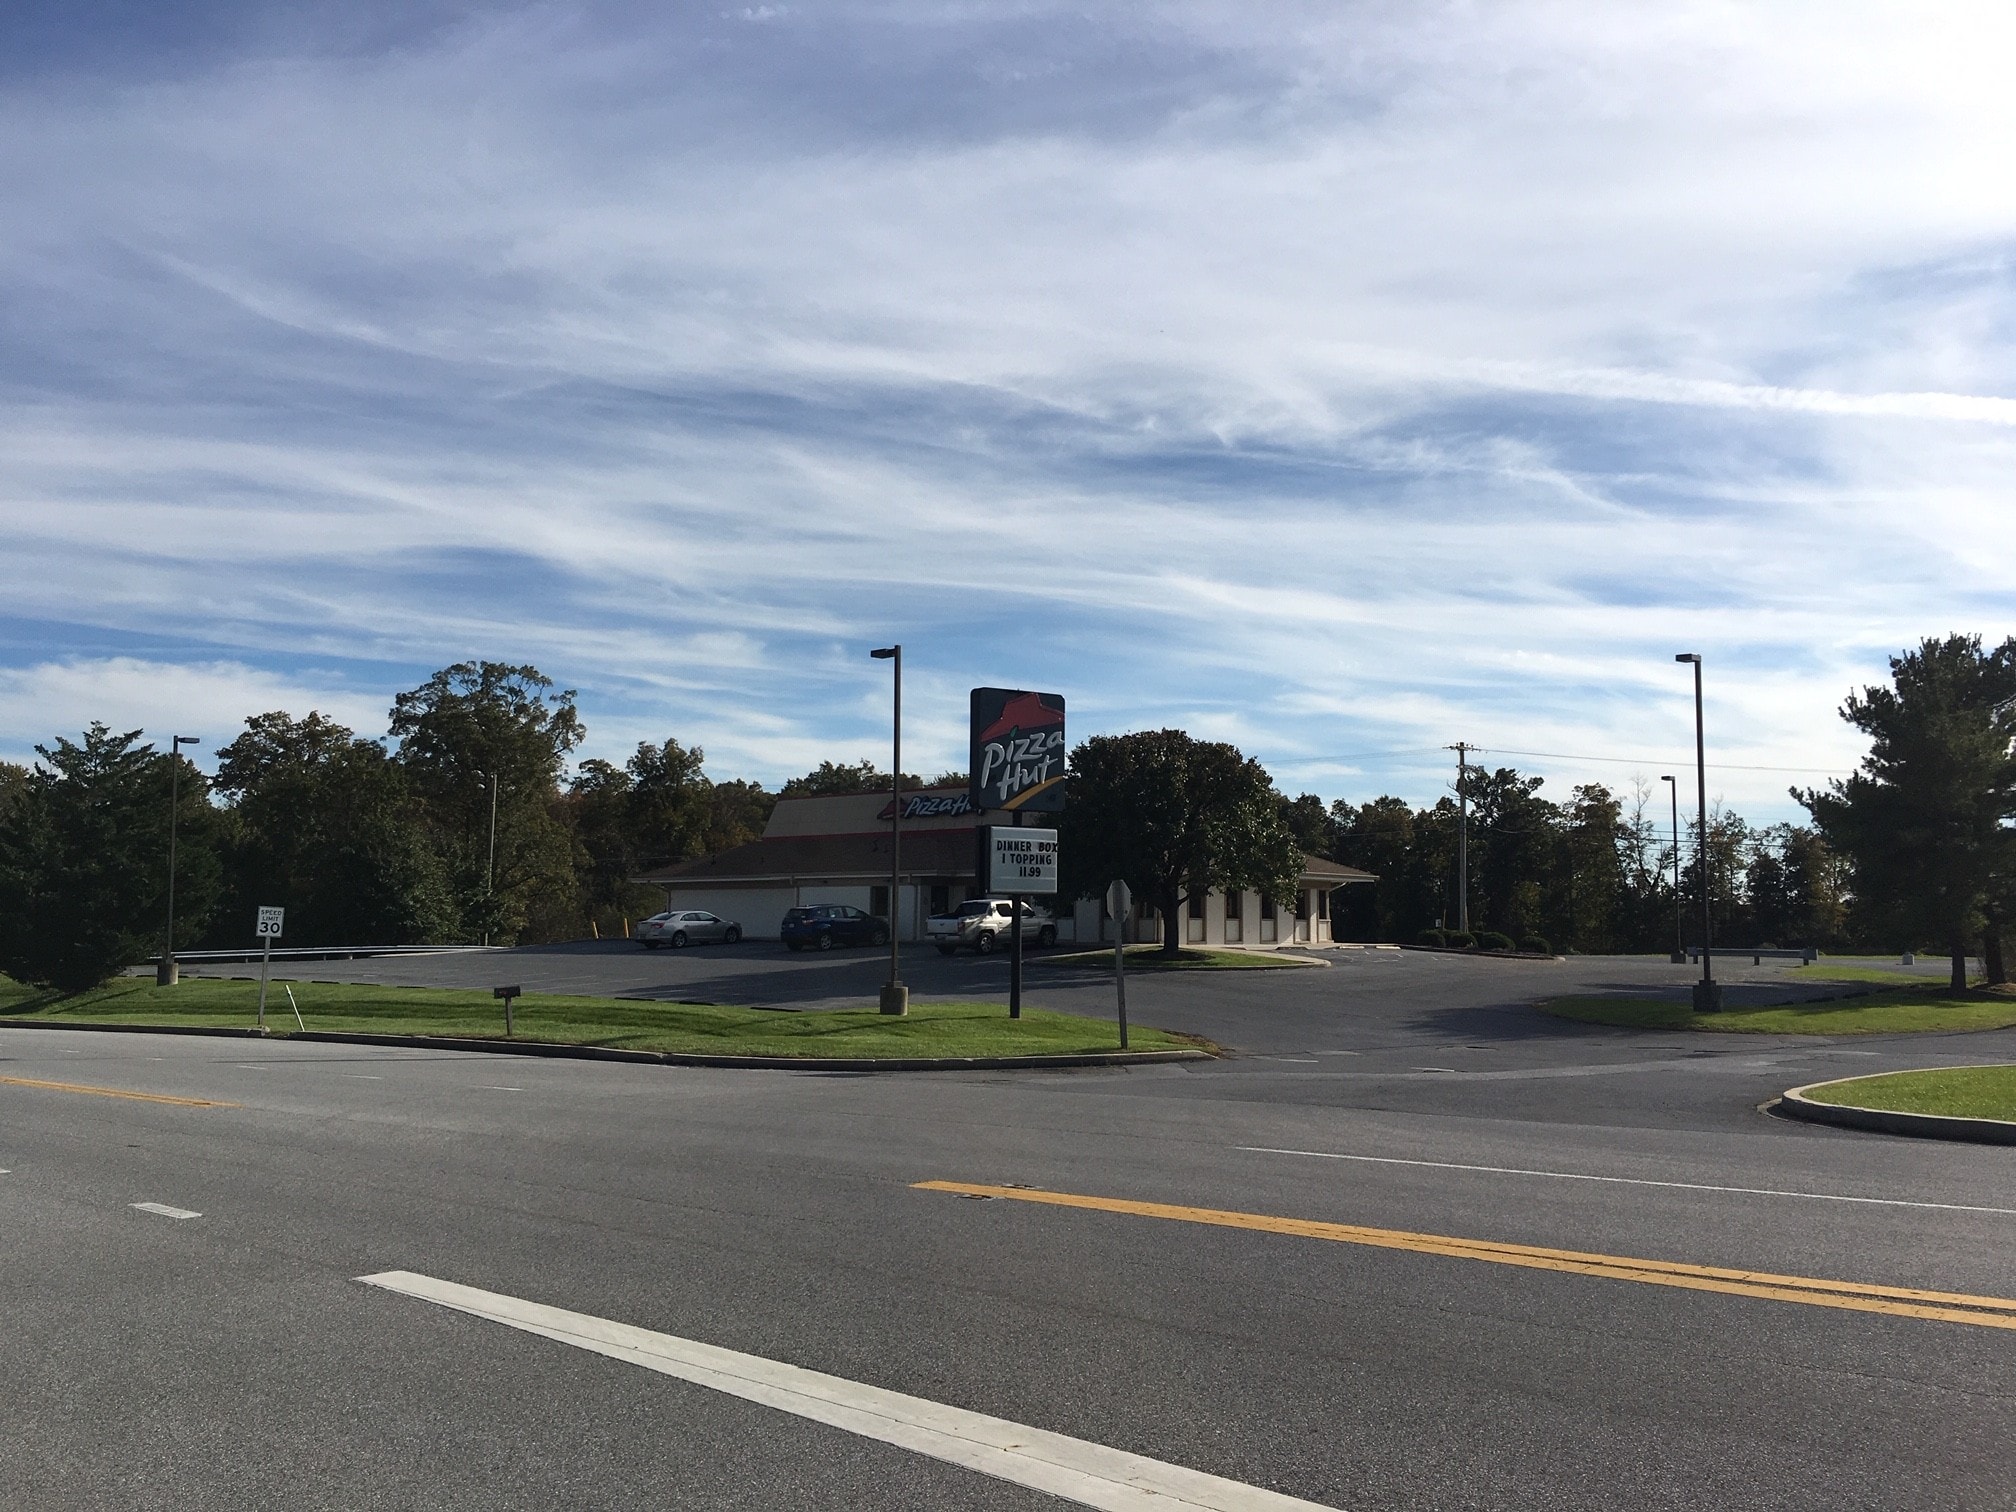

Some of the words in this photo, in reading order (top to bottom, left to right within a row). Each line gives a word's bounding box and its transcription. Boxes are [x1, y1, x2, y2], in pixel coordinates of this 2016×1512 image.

[981, 730, 1065, 789] Pizza
[996, 754, 1058, 801] Hut
[904, 797, 952, 819] Pizza
[996, 840, 1032, 852] DINNER
[1038, 841, 1058, 852] BOX
[1010, 853, 1052, 865] TOPPING
[1019, 866, 1041, 877] 11.99
[259, 921, 280, 933] 30
